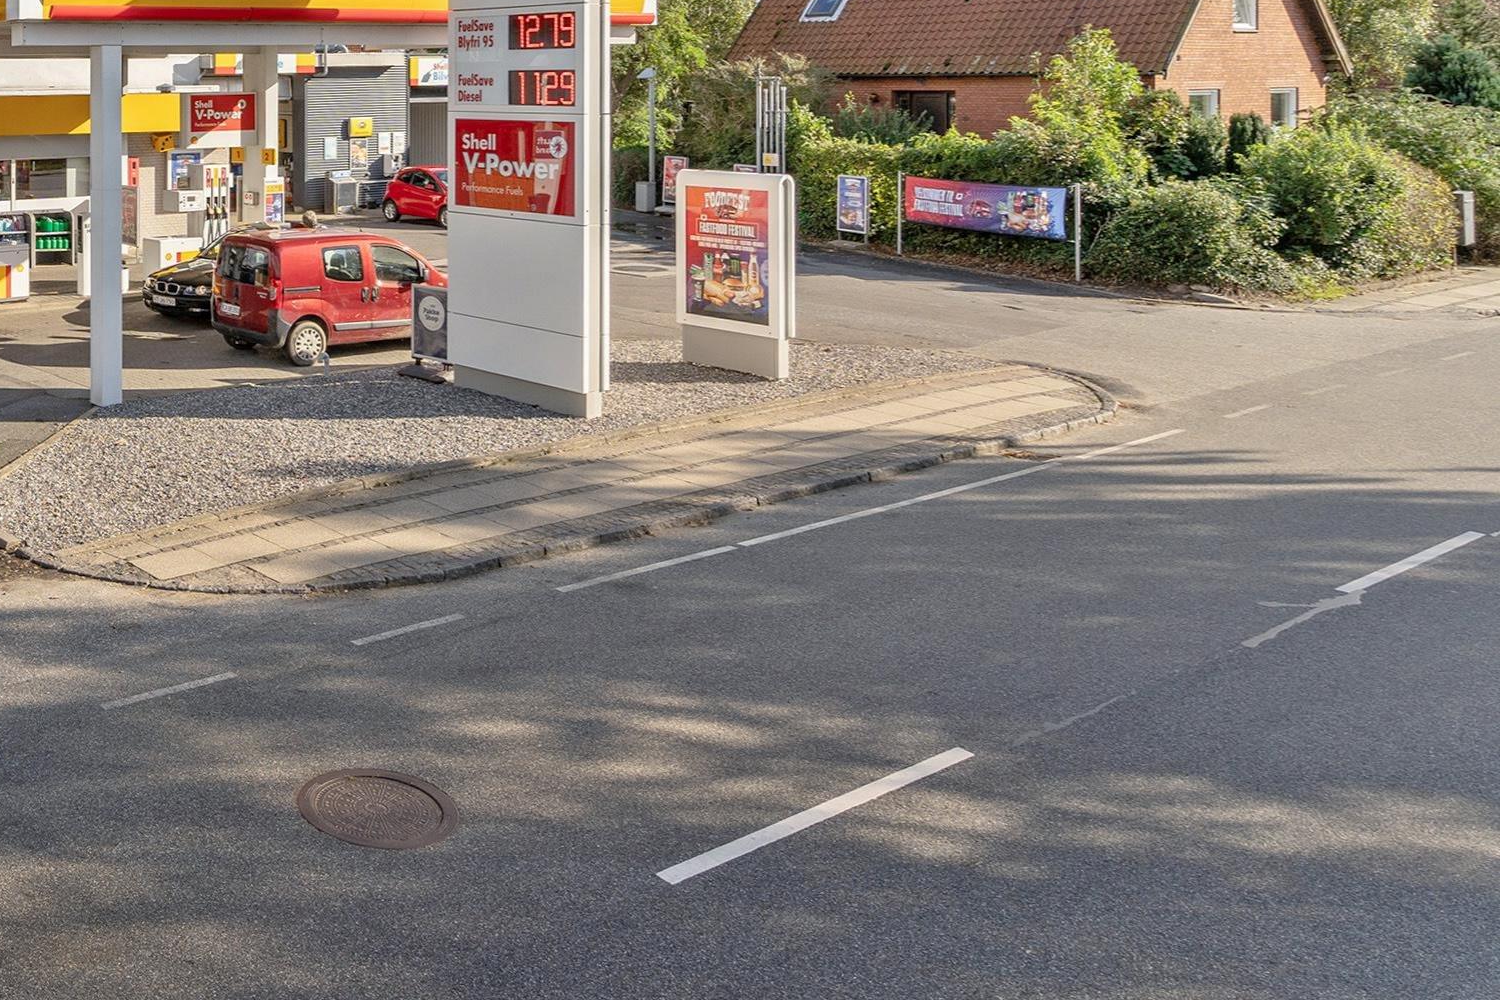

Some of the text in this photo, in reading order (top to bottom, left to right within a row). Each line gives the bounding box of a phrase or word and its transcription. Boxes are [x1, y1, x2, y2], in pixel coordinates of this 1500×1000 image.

[458, 19, 494, 32] FuelSave
[517, 12, 575, 48] 12.79
[458, 35, 494, 51] Blyfri 95
[458, 73, 494, 86] FuelSave
[458, 89, 482, 102] Diesel
[194, 100, 213, 109] Shell
[195, 109, 243, 120] V-Power
[462, 133, 497, 150] Shell
[462, 151, 560, 180] V-Power
[462, 182, 524, 196] Performance Fuels
[728, 223, 756, 238] FESTIVAL
